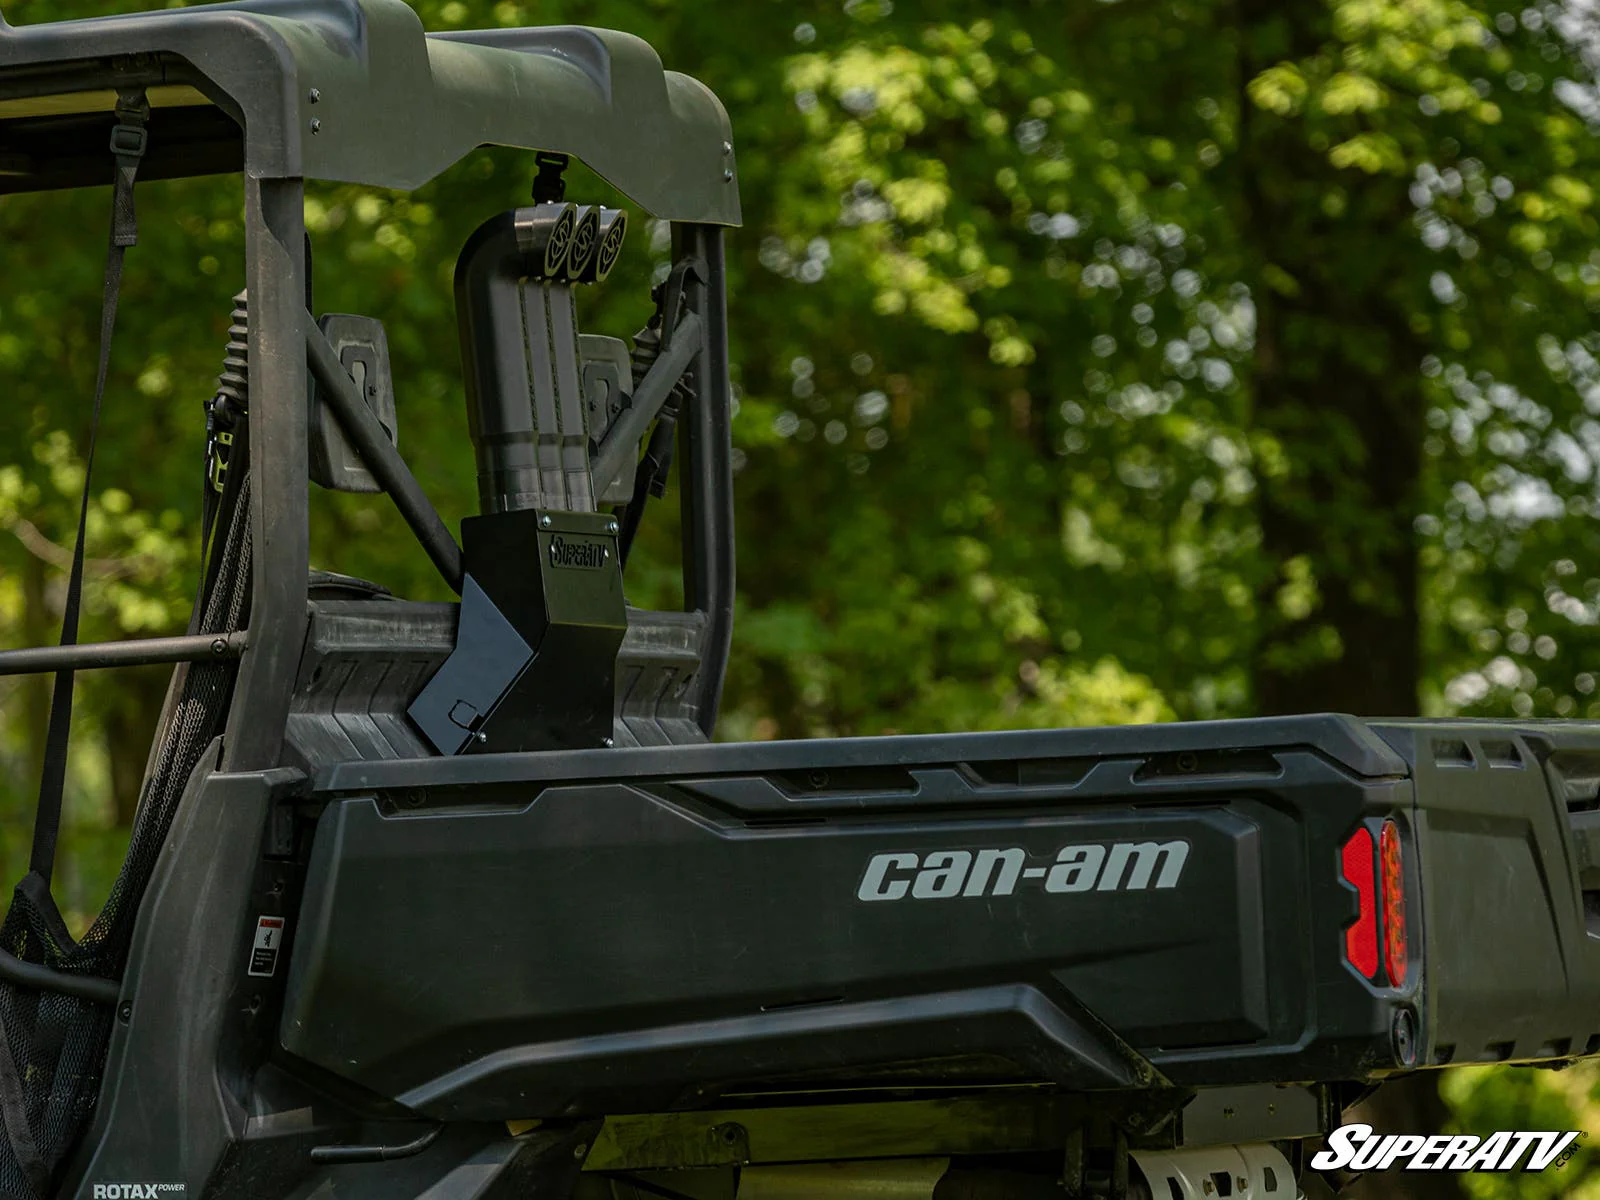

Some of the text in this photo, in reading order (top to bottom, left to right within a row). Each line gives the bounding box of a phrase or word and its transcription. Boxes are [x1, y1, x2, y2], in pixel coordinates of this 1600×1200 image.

[858, 840, 1190, 901] can-am
[93, 1183, 185, 1200] ROTAX POWER
